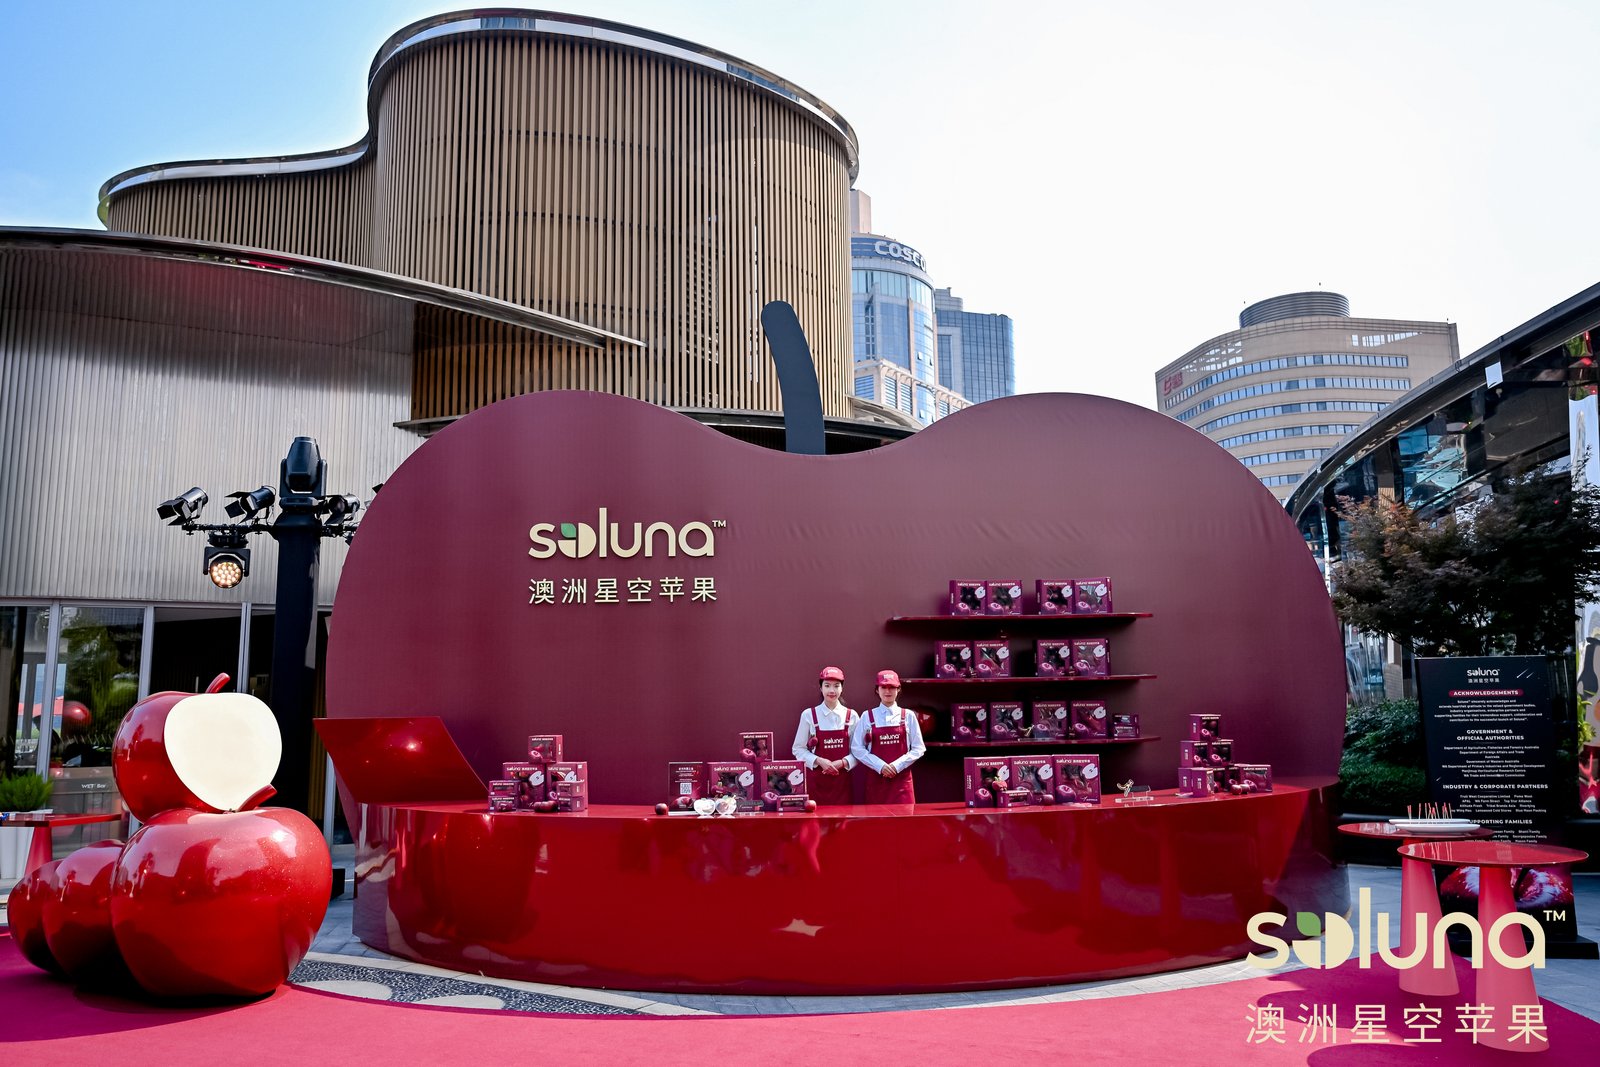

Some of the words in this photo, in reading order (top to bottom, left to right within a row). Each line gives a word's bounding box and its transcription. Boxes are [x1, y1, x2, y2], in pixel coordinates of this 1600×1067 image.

[874, 240, 926, 272] COSCO
[528, 577, 717, 605] 澳洲星空苹果
